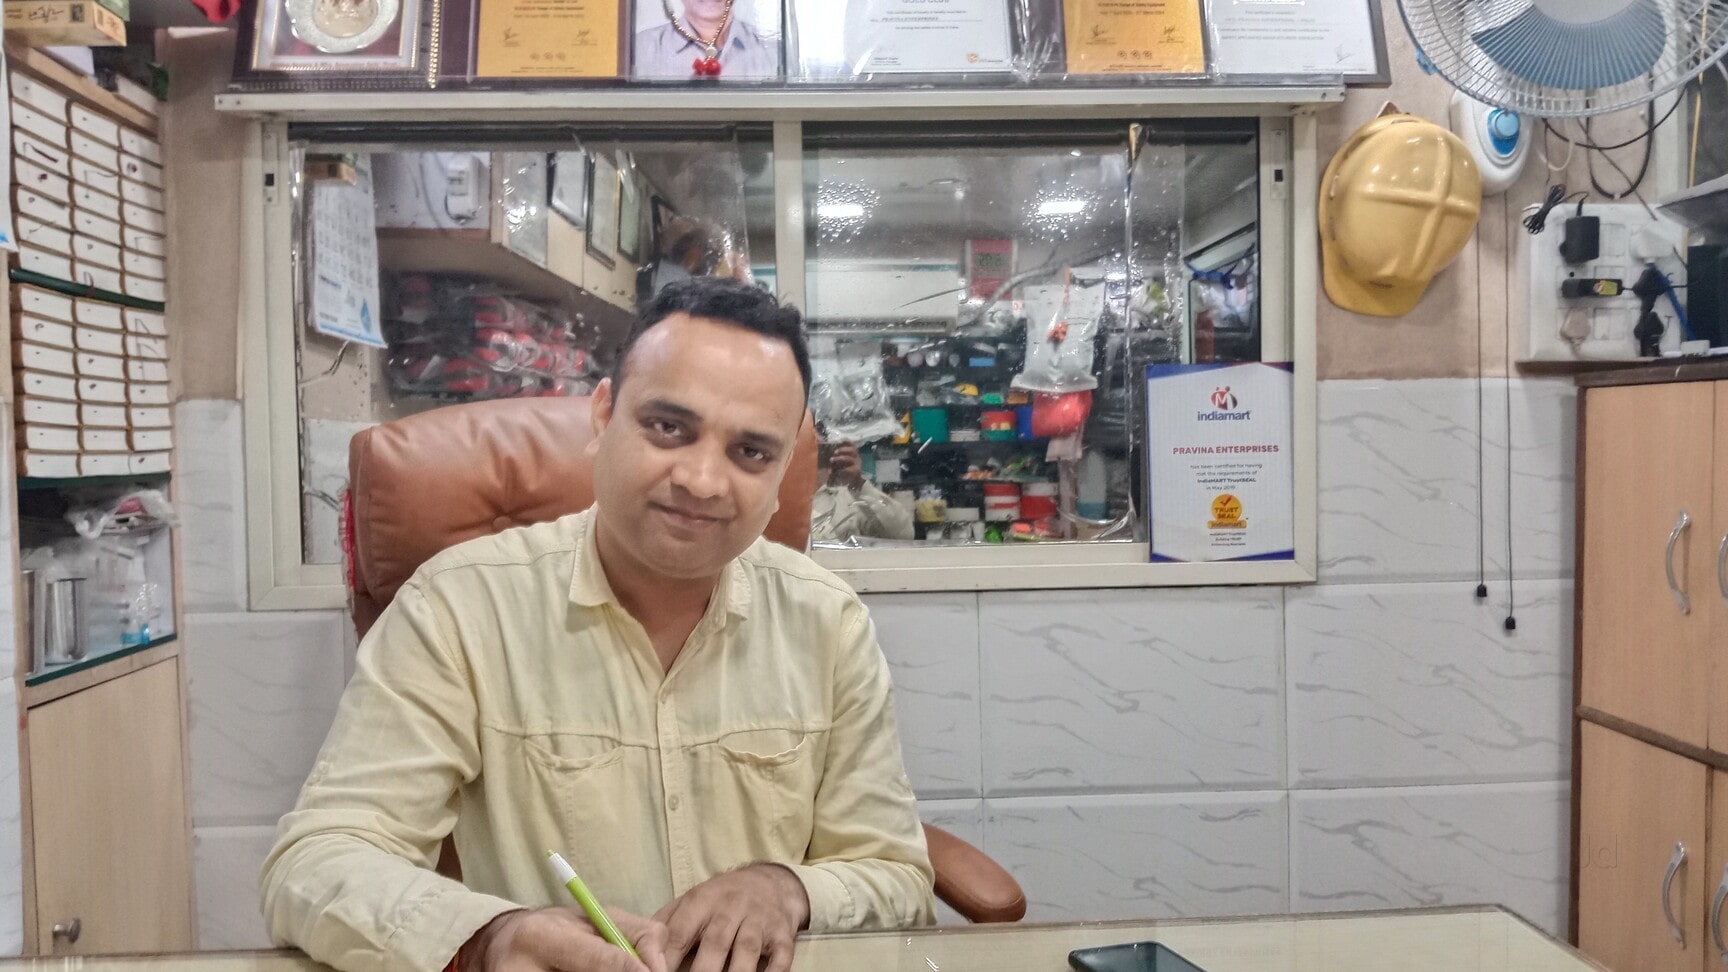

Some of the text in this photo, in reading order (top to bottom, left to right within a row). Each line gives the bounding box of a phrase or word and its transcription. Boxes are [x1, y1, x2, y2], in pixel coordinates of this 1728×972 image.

[1197, 410, 1251, 421] indiamart
[1173, 445, 1279, 455] PRAVINA ENTERPRISES
